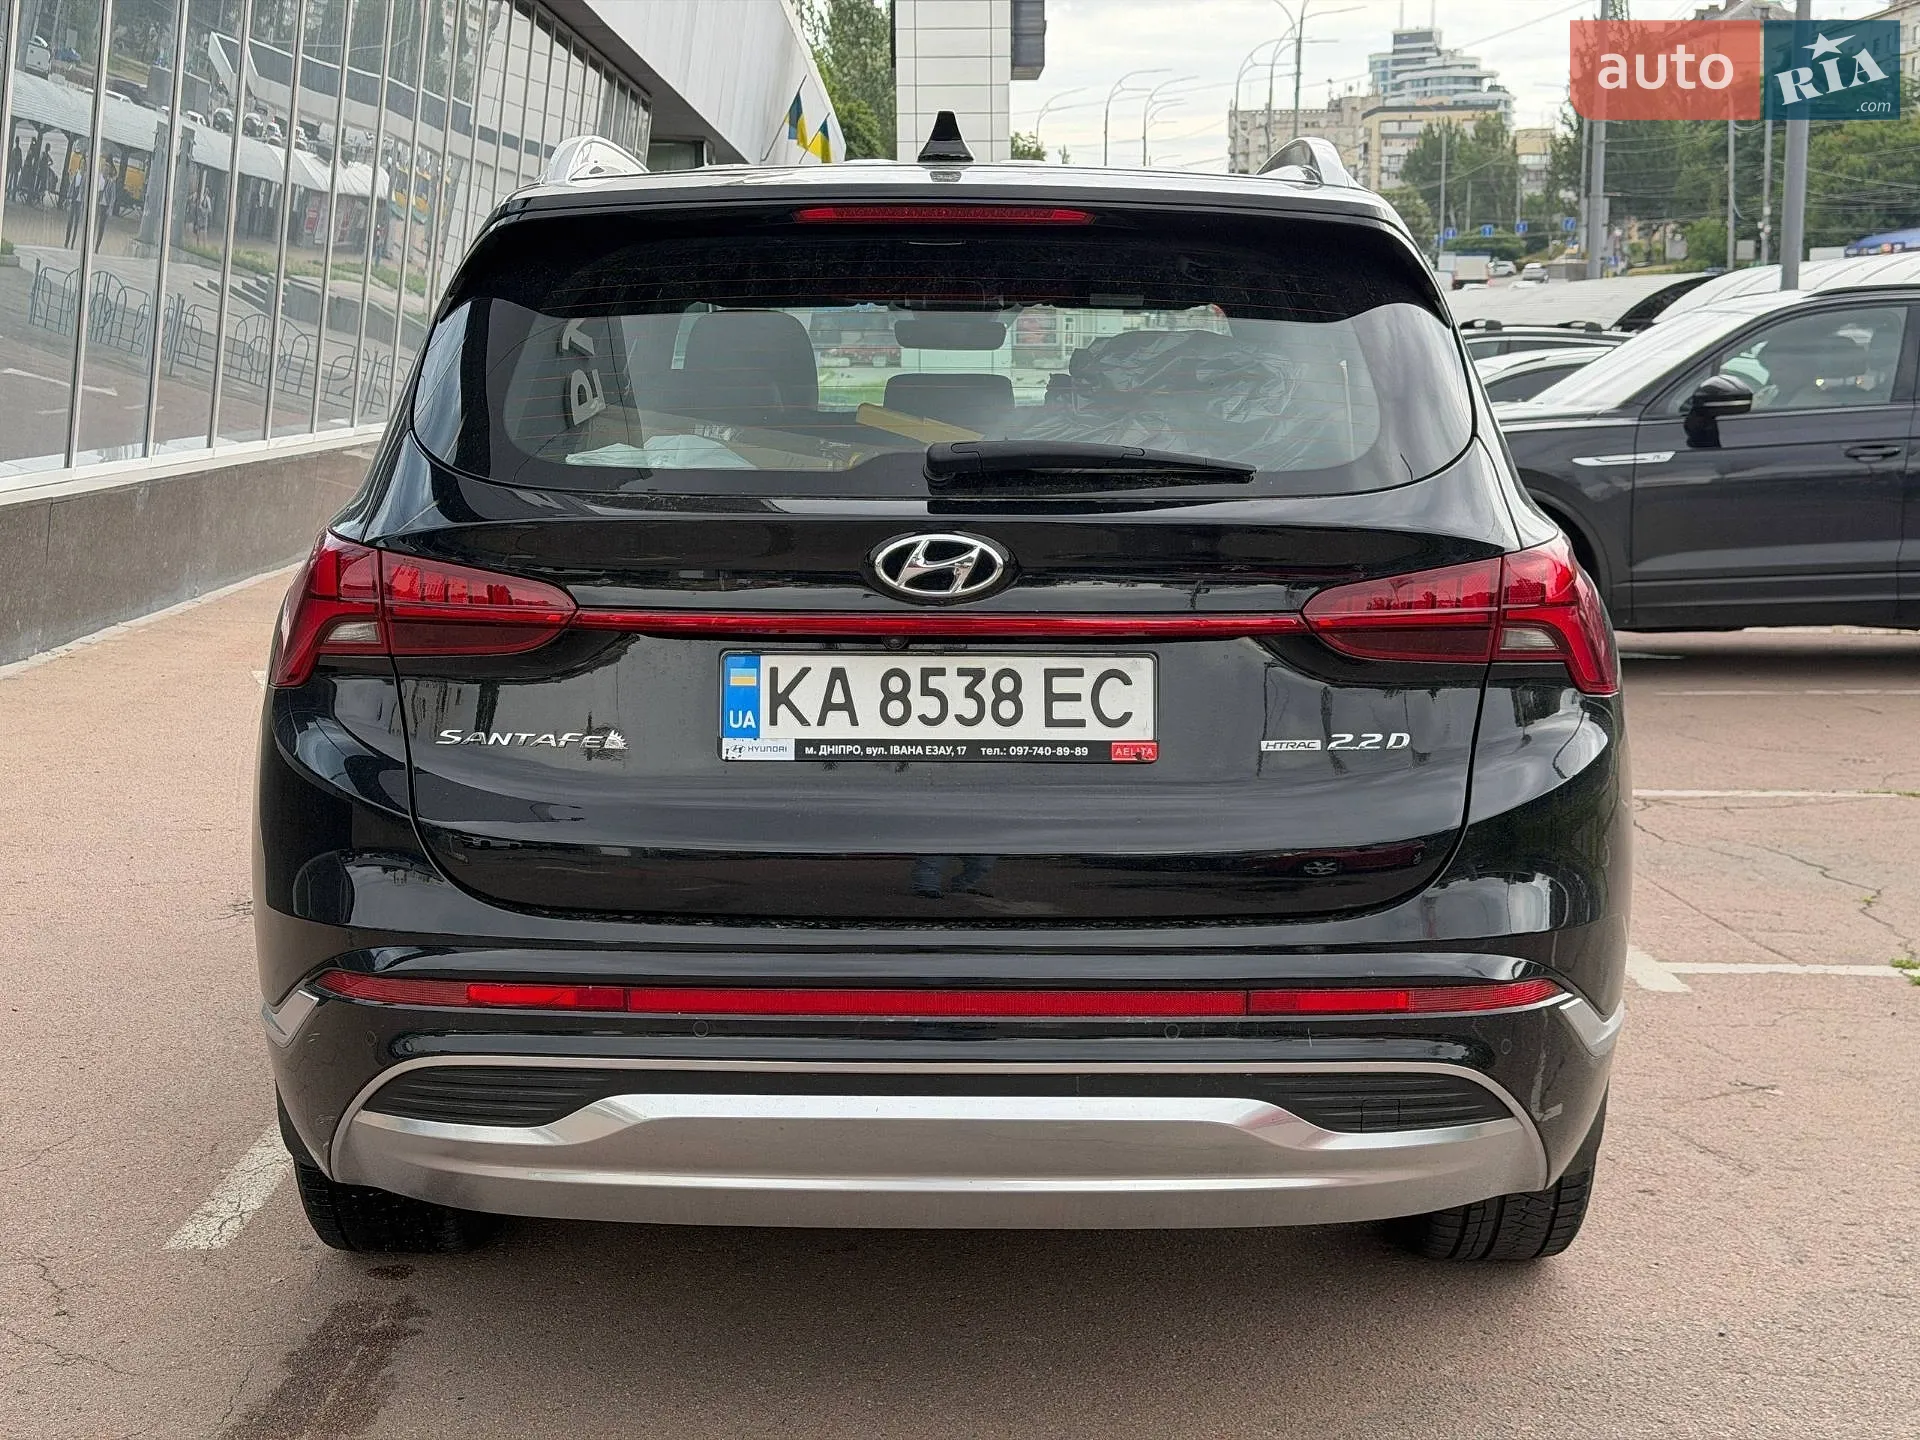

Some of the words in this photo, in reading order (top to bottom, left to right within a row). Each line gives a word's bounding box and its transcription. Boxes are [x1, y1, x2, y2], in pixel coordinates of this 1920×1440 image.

[768, 666, 860, 727] KA
[879, 667, 1024, 728] 8538
[1043, 667, 1134, 729] EC
[729, 711, 756, 728] UA
[747, 745, 788, 753] HYUNDAI
[805, 746, 817, 755] м.
[818, 744, 864, 756] ДНІПРО,
[865, 746, 888, 757] вул.
[889, 745, 924, 755] ІВАНА
[925, 745, 955, 757] ЕЗАУ,
[956, 745, 967, 755] 17
[980, 746, 1007, 756] тел.:
[1009, 745, 1089, 756] 097-740-89-89
[1265, 742, 1318, 750] HTRAC
